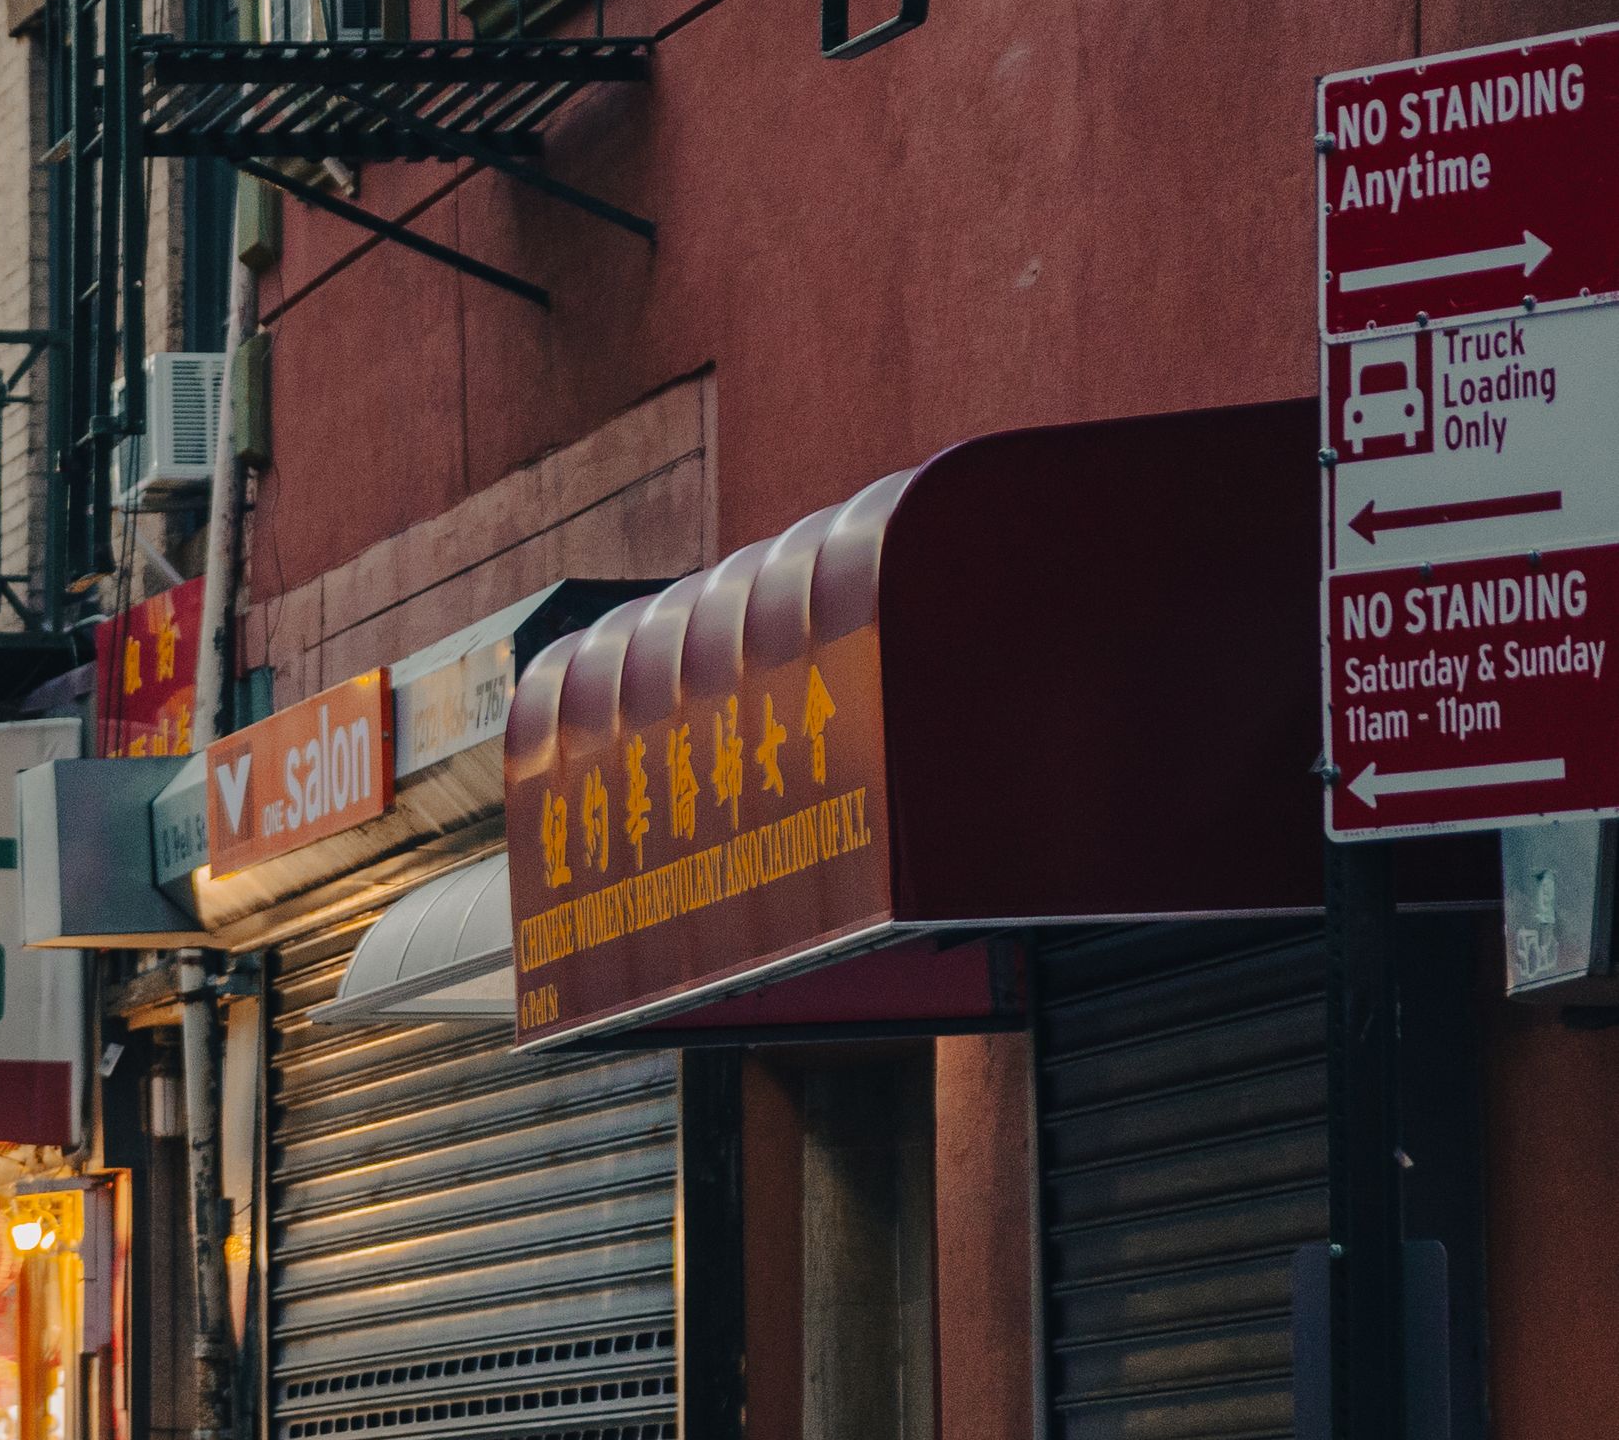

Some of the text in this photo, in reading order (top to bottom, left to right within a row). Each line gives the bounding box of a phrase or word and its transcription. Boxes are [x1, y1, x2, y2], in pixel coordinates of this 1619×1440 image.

[1337, 63, 1585, 151] NO STANDING
[1339, 150, 1491, 214] Anytime
[1443, 319, 1526, 365] Truck
[1443, 362, 1556, 409] Loading
[1444, 411, 1508, 454] Only
[1343, 570, 1587, 640] NO STANDING
[1345, 634, 1606, 694] Saturday & Sunday
[1345, 706, 1409, 743] 11am
[1436, 696, 1502, 741] 11pm
[262, 704, 372, 838] ONE salon
[520, 786, 872, 973] CHINESE WOMEN'S BENEVOLENT ASSOCIATION OF N.Y.
[521, 992, 529, 1030] 6
[529, 983, 547, 1028] Pell
